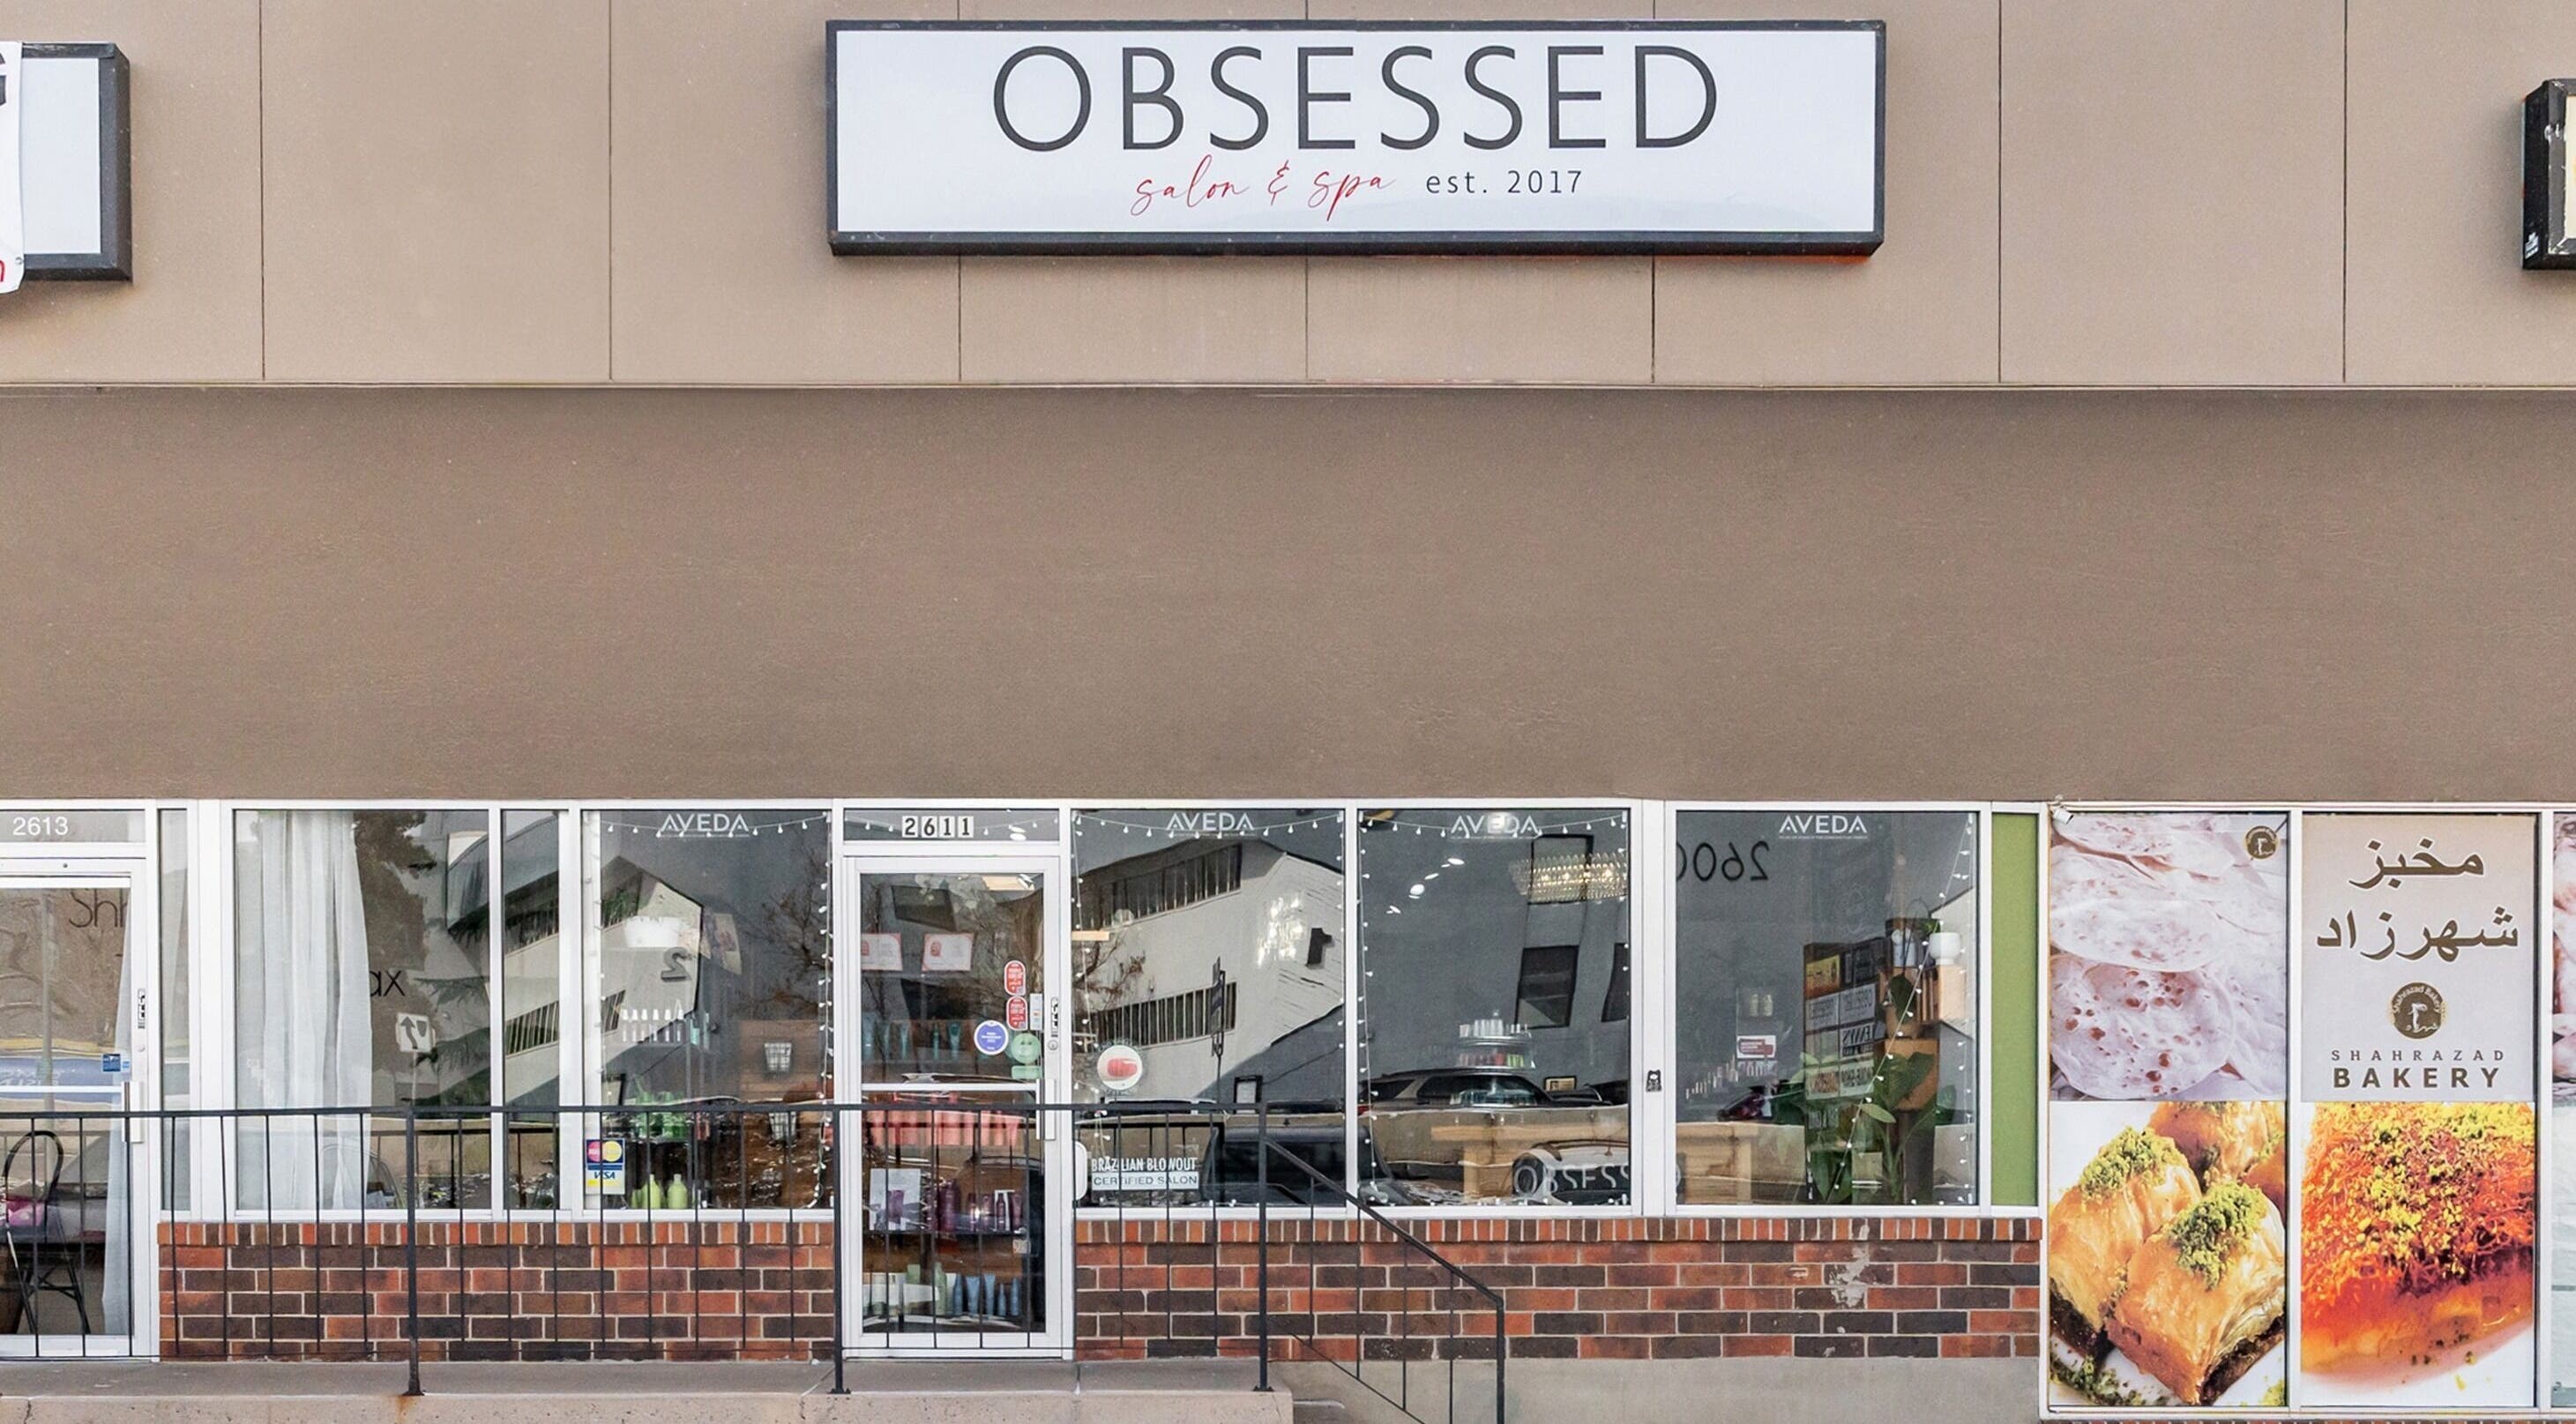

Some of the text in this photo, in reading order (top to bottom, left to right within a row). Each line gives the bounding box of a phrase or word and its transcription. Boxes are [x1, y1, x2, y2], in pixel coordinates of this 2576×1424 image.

[993, 45, 1718, 153] OBSESSED
[1131, 154, 1582, 221] salon & spa est. 2017
[12, 816, 69, 836] 2613
[660, 813, 750, 831] AVEDA
[905, 817, 970, 836] 2611
[1165, 812, 1255, 831] AVEDA
[1450, 815, 1540, 834] AVEDA
[1779, 815, 1868, 833] AVEDA
[2348, 838, 2484, 890] مخبز
[2317, 906, 2518, 963] شهرزاد
[370, 970, 406, 996] ax
[2331, 1049, 2505, 1062] SHAHRAZAD
[2333, 1067, 2499, 1088] BAKERY
[1091, 1157, 1144, 1172] BRAZLIAN
[1094, 1176, 1154, 1186] CERIFIED
